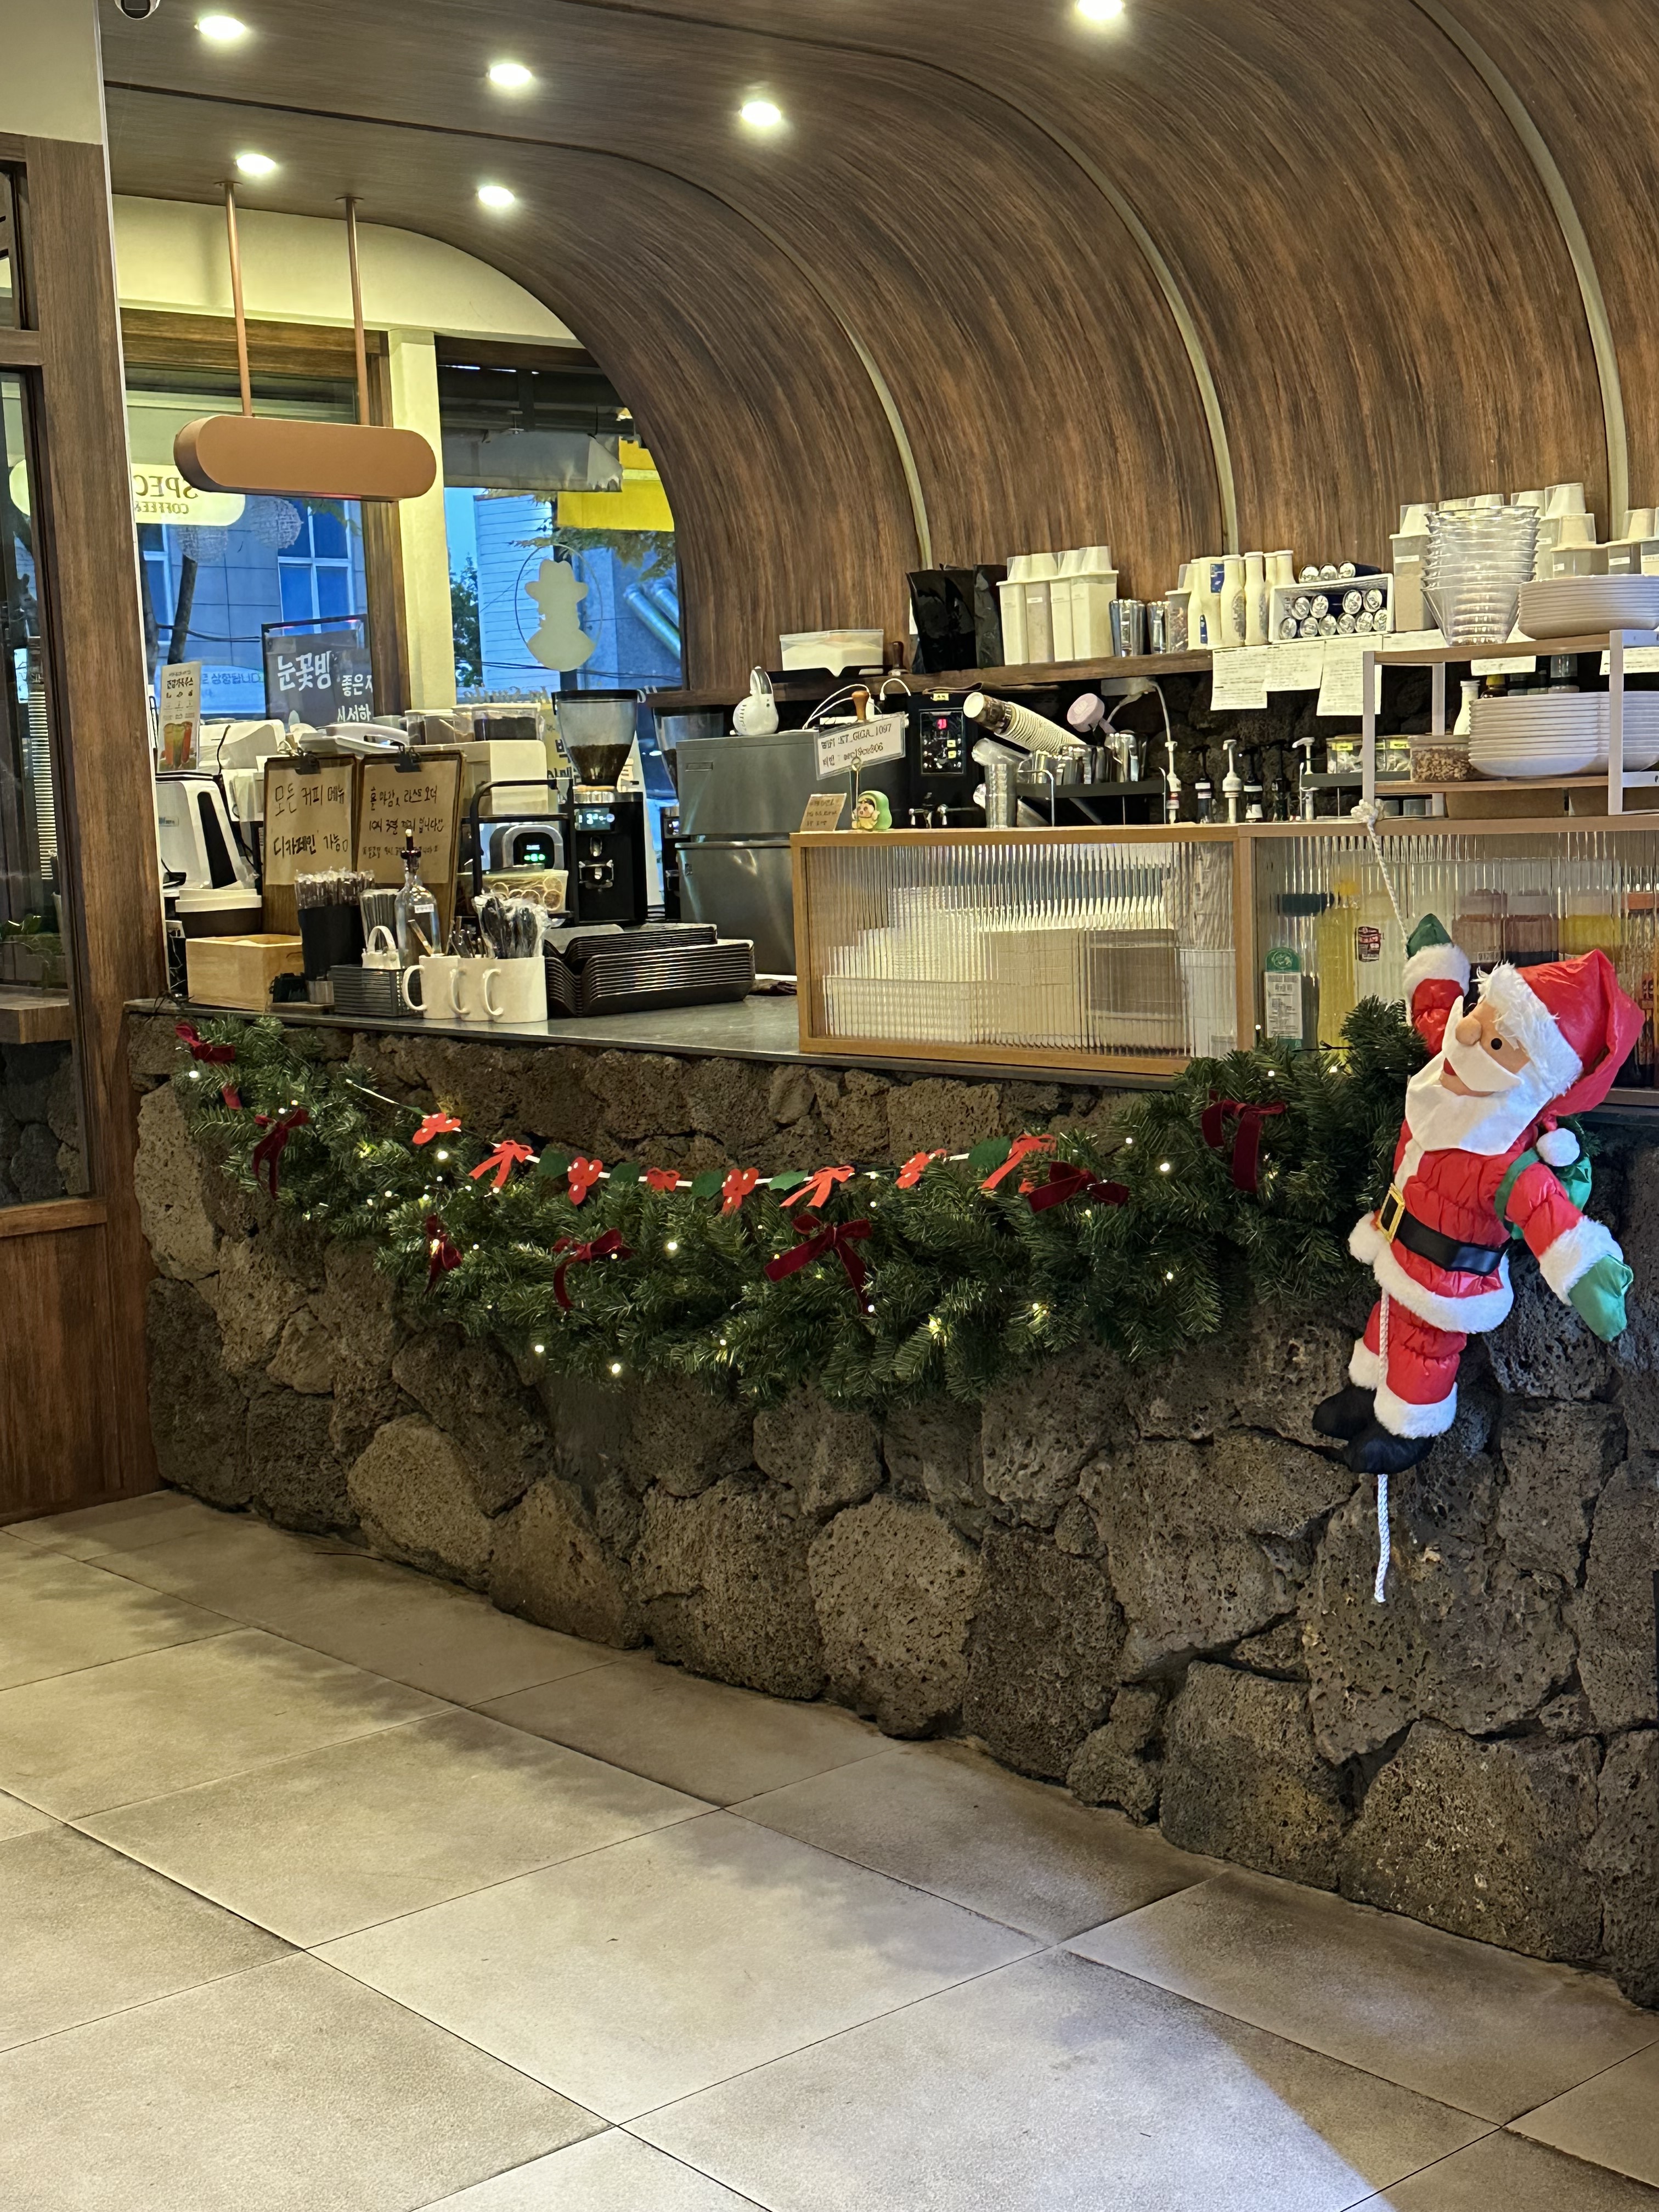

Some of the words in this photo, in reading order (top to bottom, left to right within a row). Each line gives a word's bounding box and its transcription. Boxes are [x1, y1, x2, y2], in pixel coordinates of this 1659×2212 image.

[278, 651, 332, 691] 눈꽃빙
[275, 783, 297, 816] 모든
[301, 785, 323, 806] 커피
[273, 834, 317, 859] 디카페인
